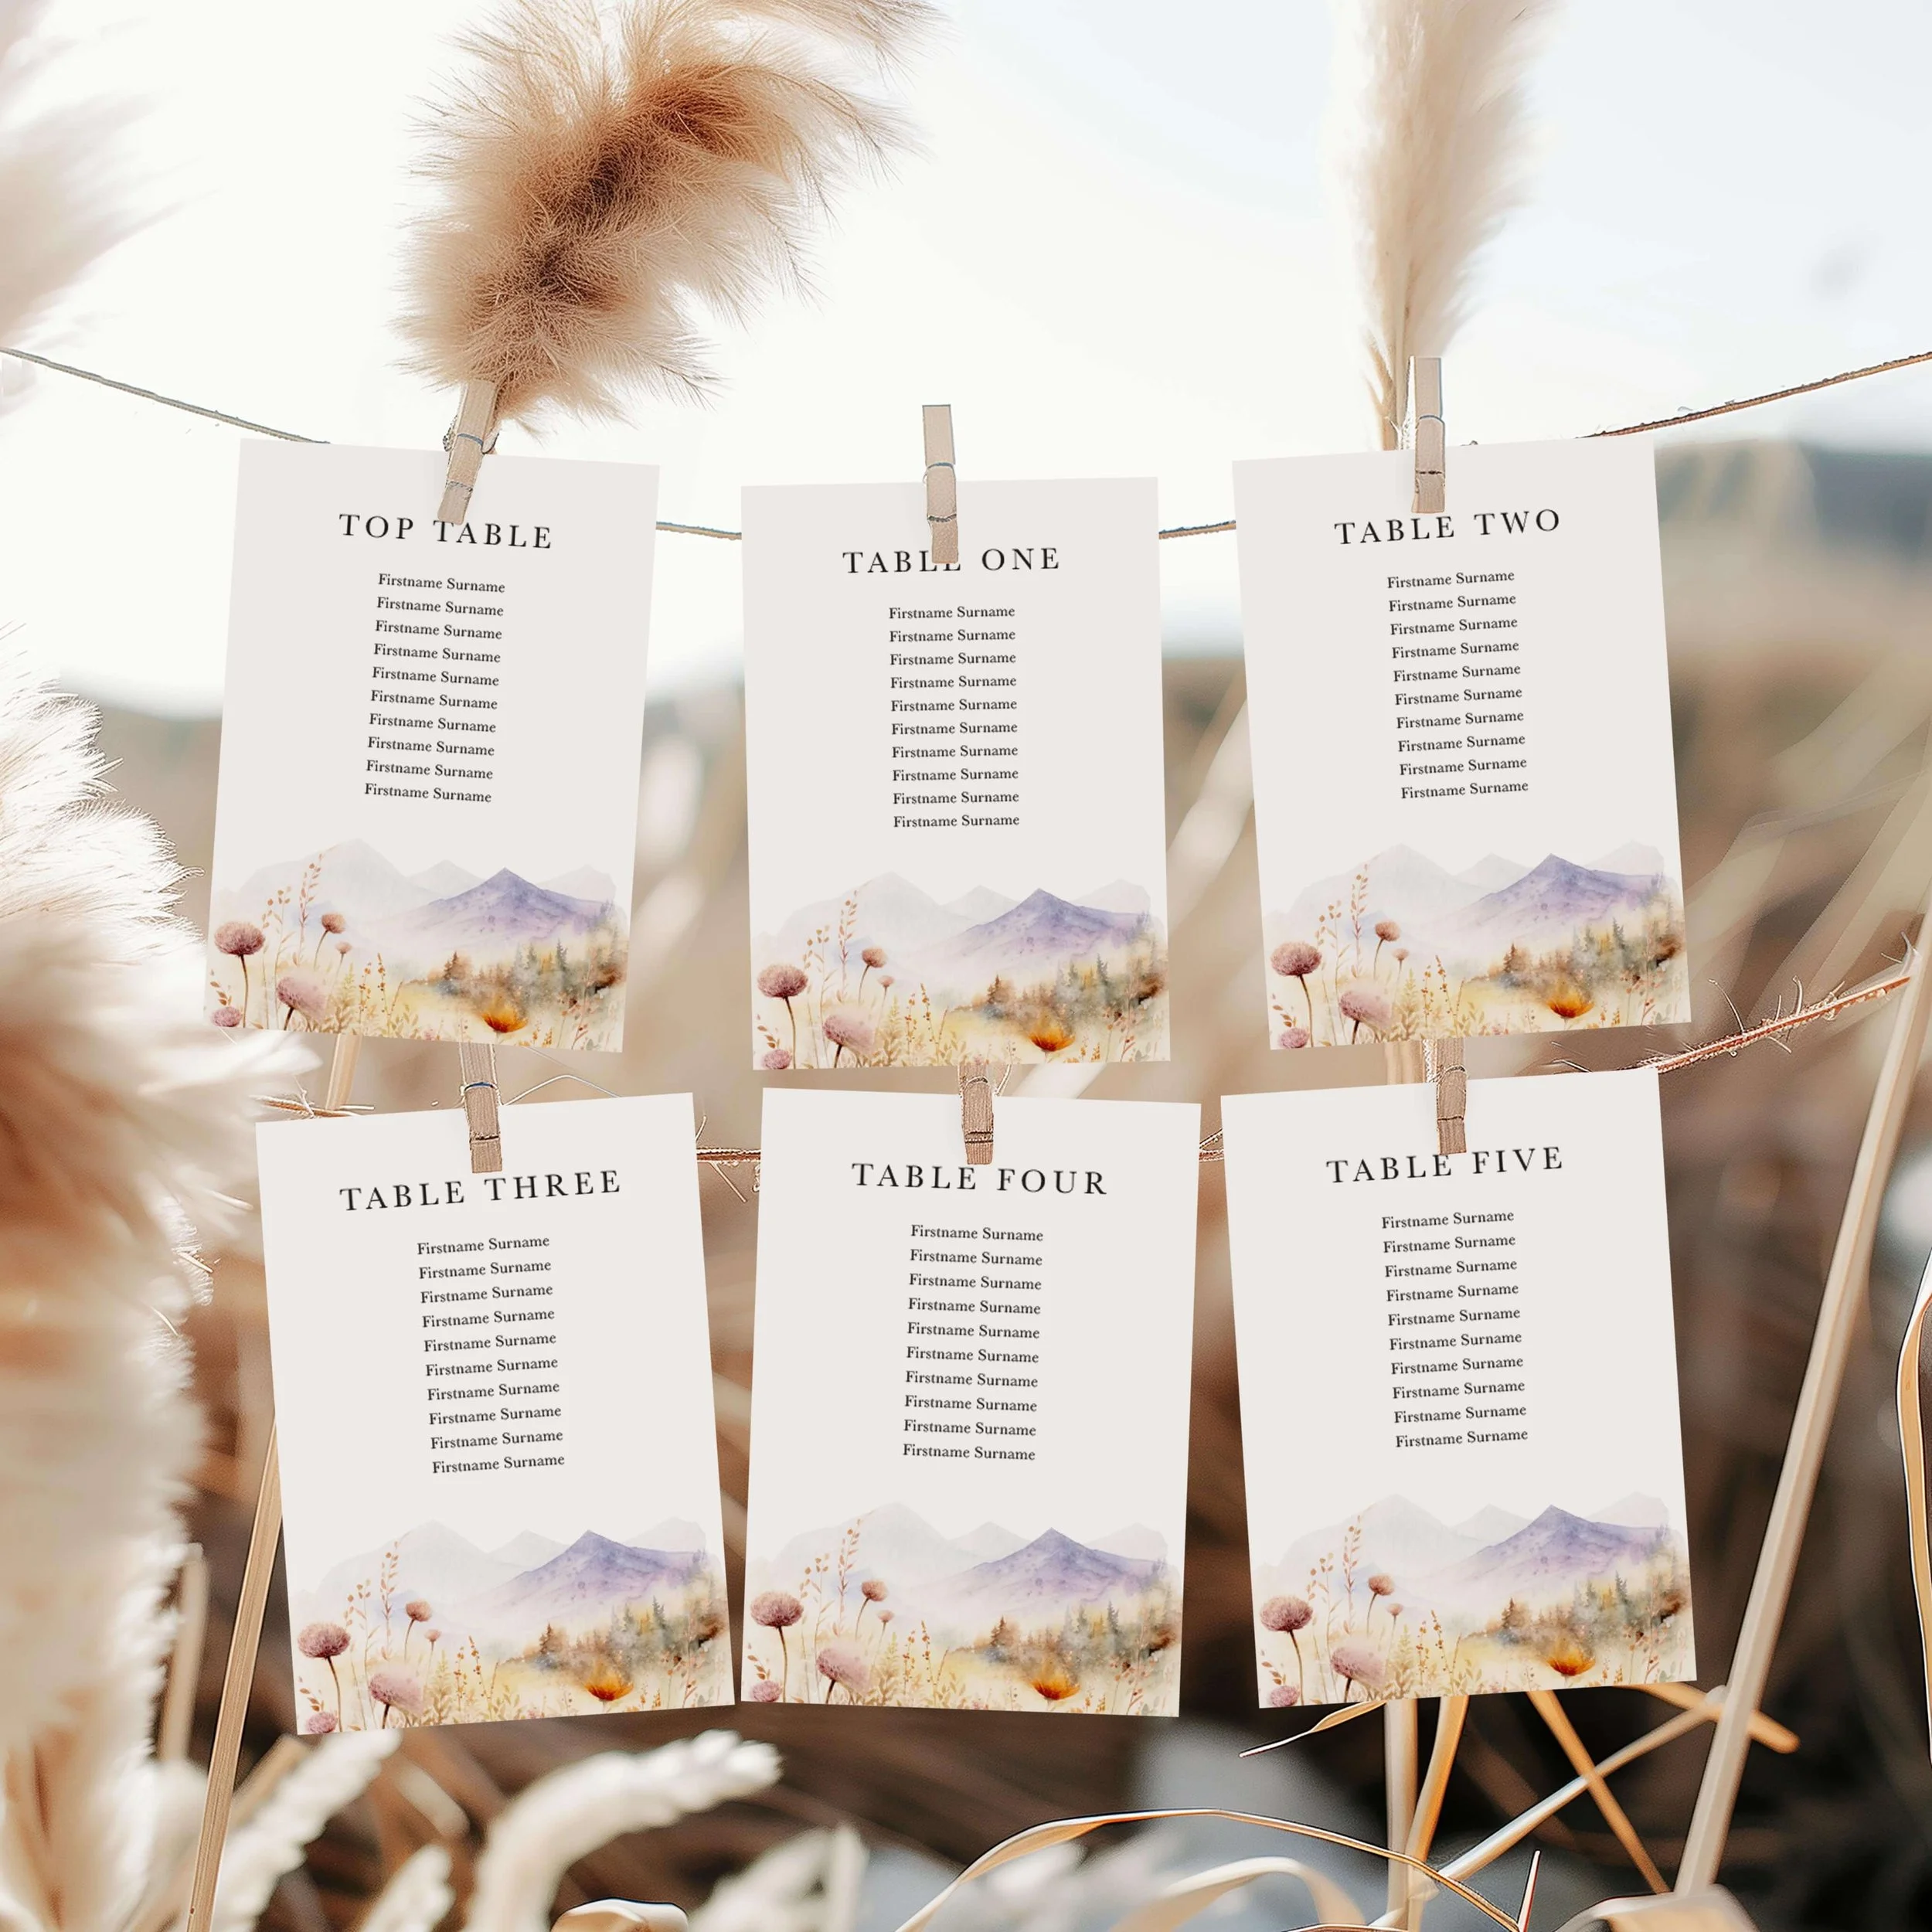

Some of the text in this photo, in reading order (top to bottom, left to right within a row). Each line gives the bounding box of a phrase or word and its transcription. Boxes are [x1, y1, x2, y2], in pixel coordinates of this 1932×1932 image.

[339, 514, 550, 549] TOP TABLE
[1334, 509, 1559, 545] TABLE TWO
[842, 547, 1059, 573] TABL ONE
[378, 573, 505, 594] Firstname Surname
[1387, 572, 1515, 589] Firstname Surname
[376, 596, 504, 617] Firstname Surname
[889, 606, 1015, 619] Firstname Surname
[1389, 595, 1516, 612] Firstname Surname
[376, 620, 502, 640] Firstname Surname
[889, 629, 1016, 642] Firstname Surname
[1390, 618, 1518, 635] Firstname Surname
[373, 643, 501, 663] Firstname Surname
[889, 651, 1016, 665] Firstname Surname
[1392, 642, 1519, 659] Firstname Surname
[372, 666, 499, 686] Firstname Surname
[890, 675, 1017, 689] Firstname Surname
[1393, 665, 1521, 682] Firstname Surname
[370, 689, 498, 710] Firstname Surname
[891, 699, 1017, 712] Firstname Surname
[1395, 689, 1522, 706] Firstname Surname
[369, 713, 496, 733] Firstname Surname
[891, 721, 1018, 735] Firstname Surname
[1396, 712, 1524, 729] Firstname Surname
[367, 736, 495, 757] Firstname Surname
[892, 744, 1019, 758] Firstname Surname
[1398, 736, 1526, 753] Firstname Surname
[366, 759, 493, 780] Firstname Surname
[893, 767, 1019, 781] Firstname Surname
[1400, 759, 1527, 776] Firstname Surname
[364, 782, 492, 803] Firstname Surname
[893, 791, 1019, 804] Firstname Surname
[1401, 782, 1529, 799] Firstname Surname
[893, 814, 1020, 828] Firstname Surname
[1326, 1146, 1562, 1183] TABLE FIVE
[852, 1163, 1107, 1195] TABLE FOUR
[339, 1170, 620, 1211] TABLE THREE
[1382, 1212, 1514, 1230] Firstname Surname
[910, 1224, 1044, 1242] Firstname Surname
[417, 1237, 549, 1255] Firstname Surname
[1383, 1236, 1515, 1253] Firstname Surname
[910, 1248, 1043, 1266] Firstname Surname
[419, 1262, 551, 1280] Firstname Surname
[1385, 1260, 1517, 1277] Firstname Surname
[909, 1273, 1042, 1291] Firstname Surname
[420, 1286, 553, 1304] Firstname Surname
[1386, 1284, 1519, 1302] Firstname Surname
[908, 1297, 1041, 1315] Firstname Surname
[422, 1310, 555, 1328] Firstname Surname
[1387, 1309, 1520, 1326] Firstname Surname
[907, 1321, 1040, 1339] Firstname Surname
[423, 1335, 556, 1352] Firstname Surname
[1389, 1333, 1522, 1351] Firstname Surname
[906, 1345, 1039, 1363] Firstname Surname
[425, 1359, 558, 1376] Firstname Surname
[1391, 1358, 1523, 1375] Firstname Surname
[905, 1370, 1039, 1388] Firstname Surname
[427, 1383, 560, 1401] Firstname Surname
[1393, 1382, 1525, 1400] Firstname Surname
[904, 1394, 1037, 1412] Firstname Surname
[429, 1407, 562, 1425] Firstname Surname
[1394, 1406, 1526, 1423] Firstname Surname
[903, 1419, 1036, 1437] Firstname Surname
[430, 1432, 563, 1450] Firstname Surname
[1396, 1430, 1528, 1448] Firstname Surname
[903, 1443, 1036, 1461] Firstname Surname
[432, 1456, 565, 1474] Firstname Surname
